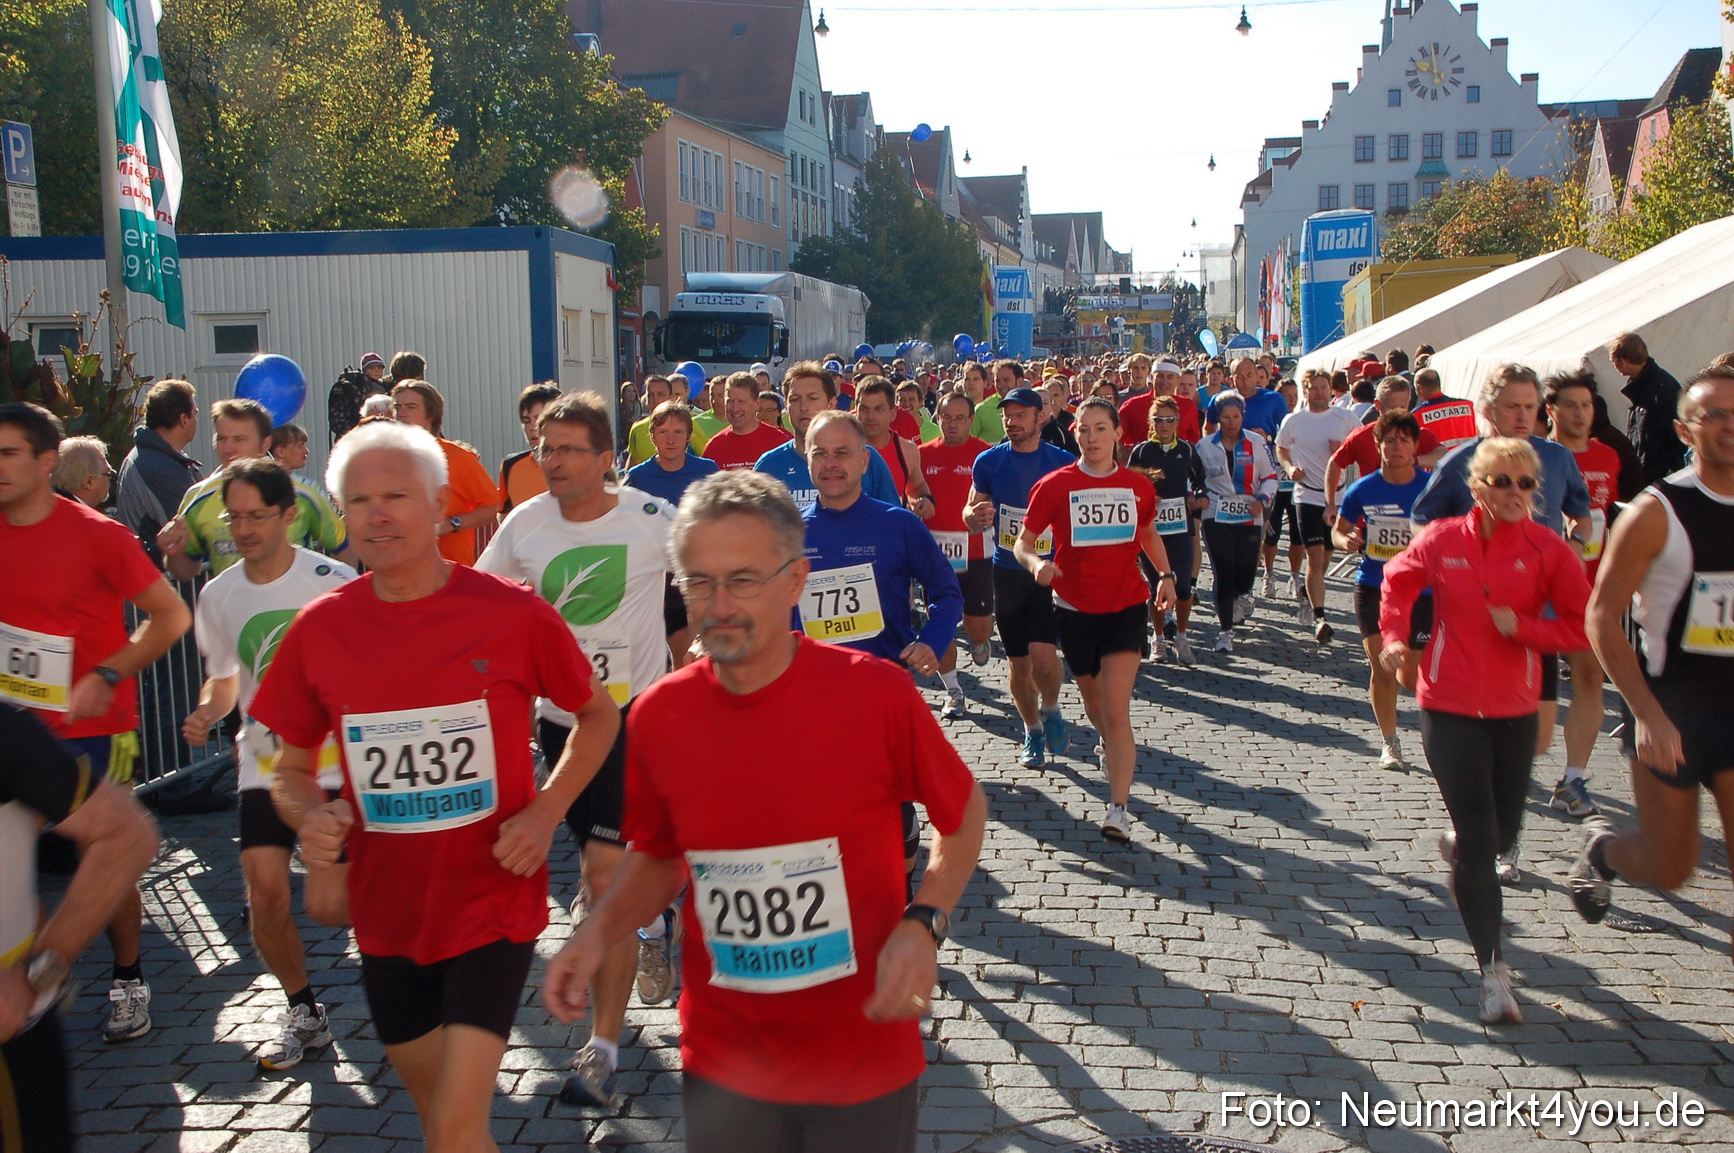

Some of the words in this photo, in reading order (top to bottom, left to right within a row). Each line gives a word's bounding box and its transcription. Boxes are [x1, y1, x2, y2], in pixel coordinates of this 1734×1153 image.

[8, 129, 26, 175] P
[1317, 222, 1368, 252] maxi
[695, 295, 746, 306] BOCK
[1007, 301, 1021, 311] dsl
[1424, 406, 1470, 422] NOTARZT
[1078, 503, 1130, 525] 3576
[1221, 501, 1250, 515] 2655
[1378, 528, 1412, 546] 855
[811, 586, 861, 618] 773
[824, 616, 856, 635] Paul
[364, 737, 479, 790] 2432
[370, 787, 483, 820] Wolfgang
[709, 881, 830, 939] 2982
[730, 943, 818, 973] Rainer
